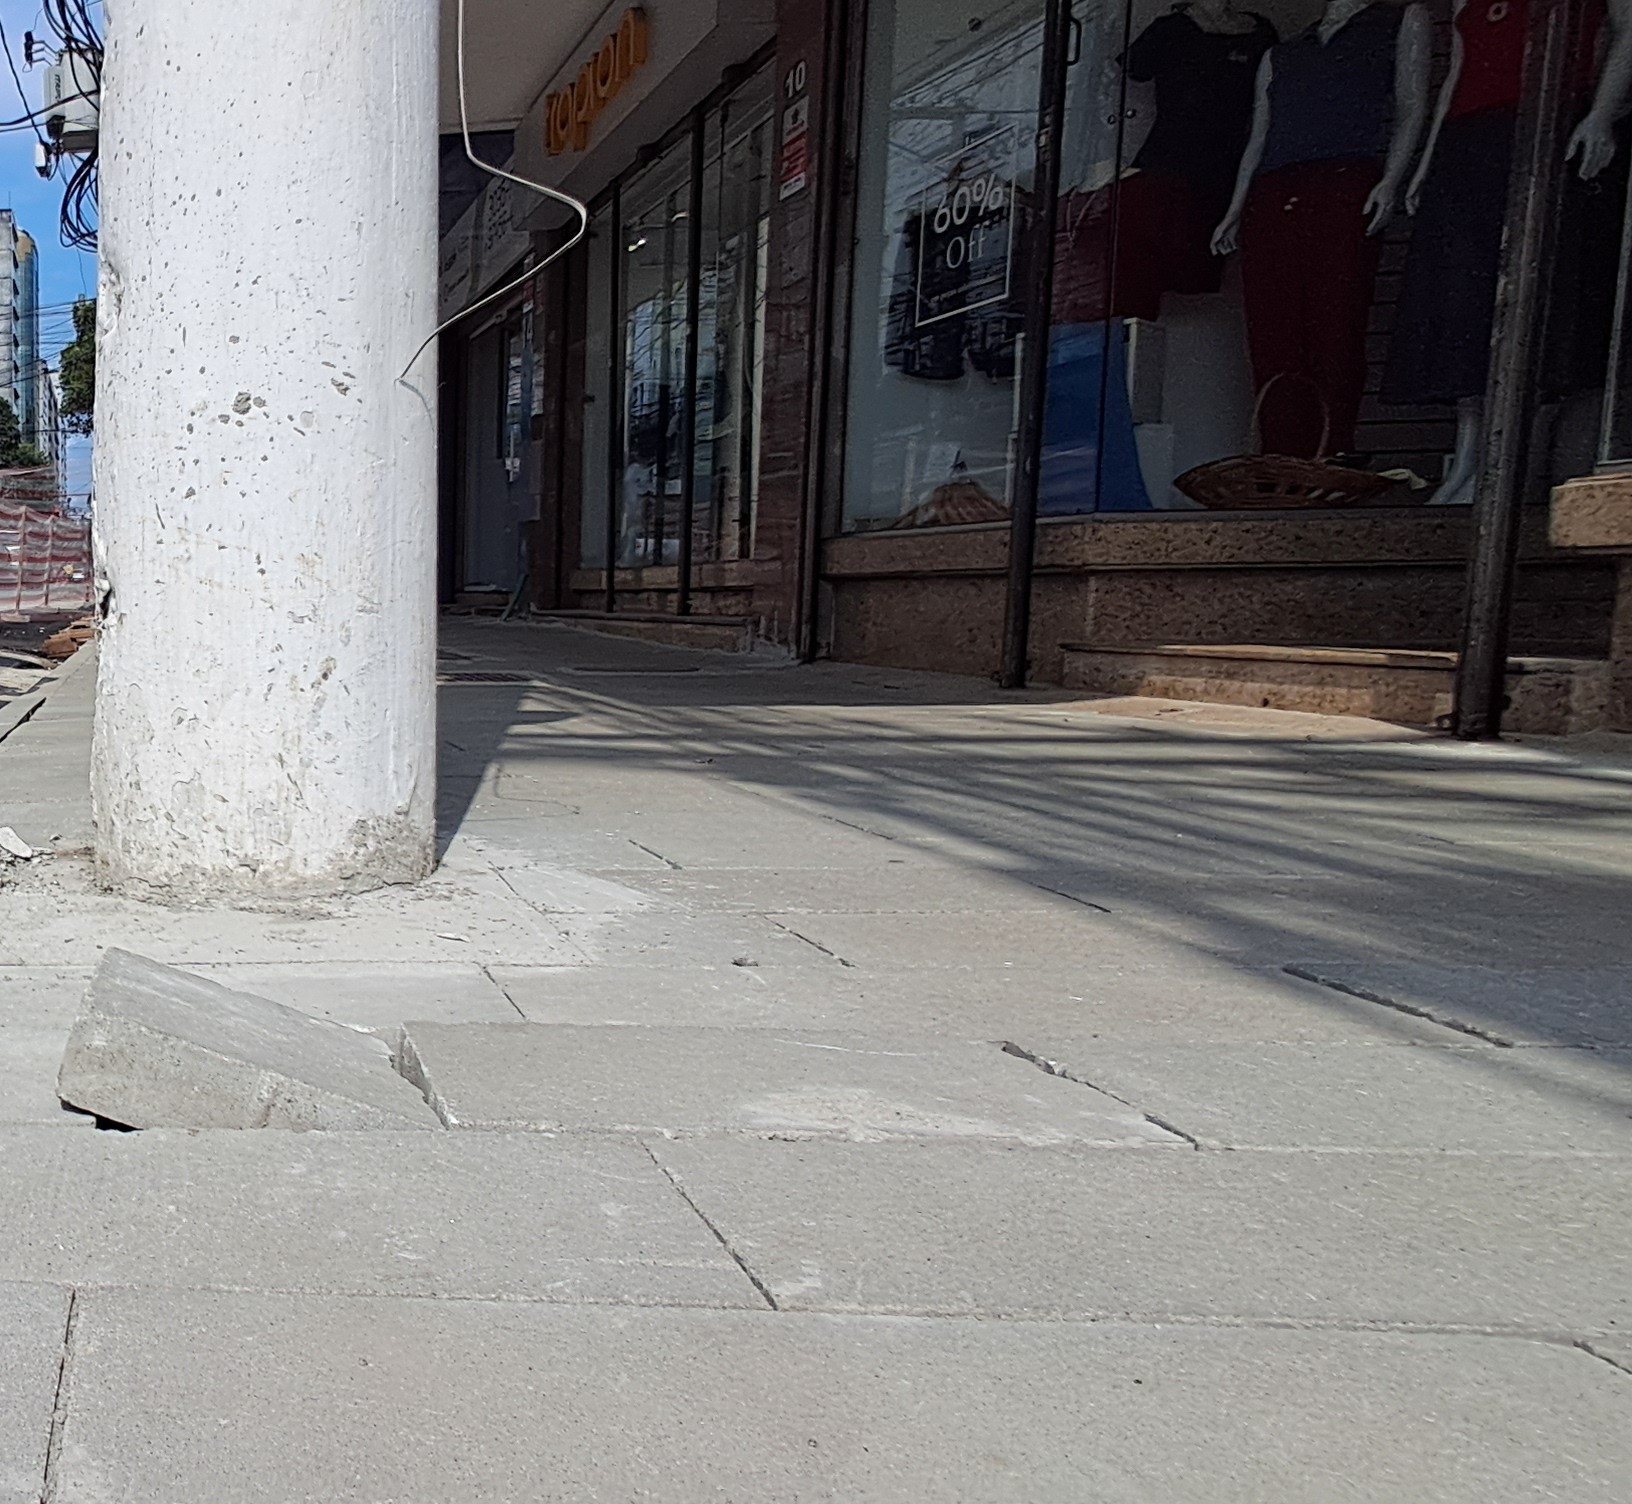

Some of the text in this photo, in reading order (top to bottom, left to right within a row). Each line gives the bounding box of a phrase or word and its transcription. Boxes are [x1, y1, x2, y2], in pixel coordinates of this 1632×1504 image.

[784, 59, 806, 99] 10
[933, 172, 1004, 235] 60%
[945, 224, 988, 270] Off
